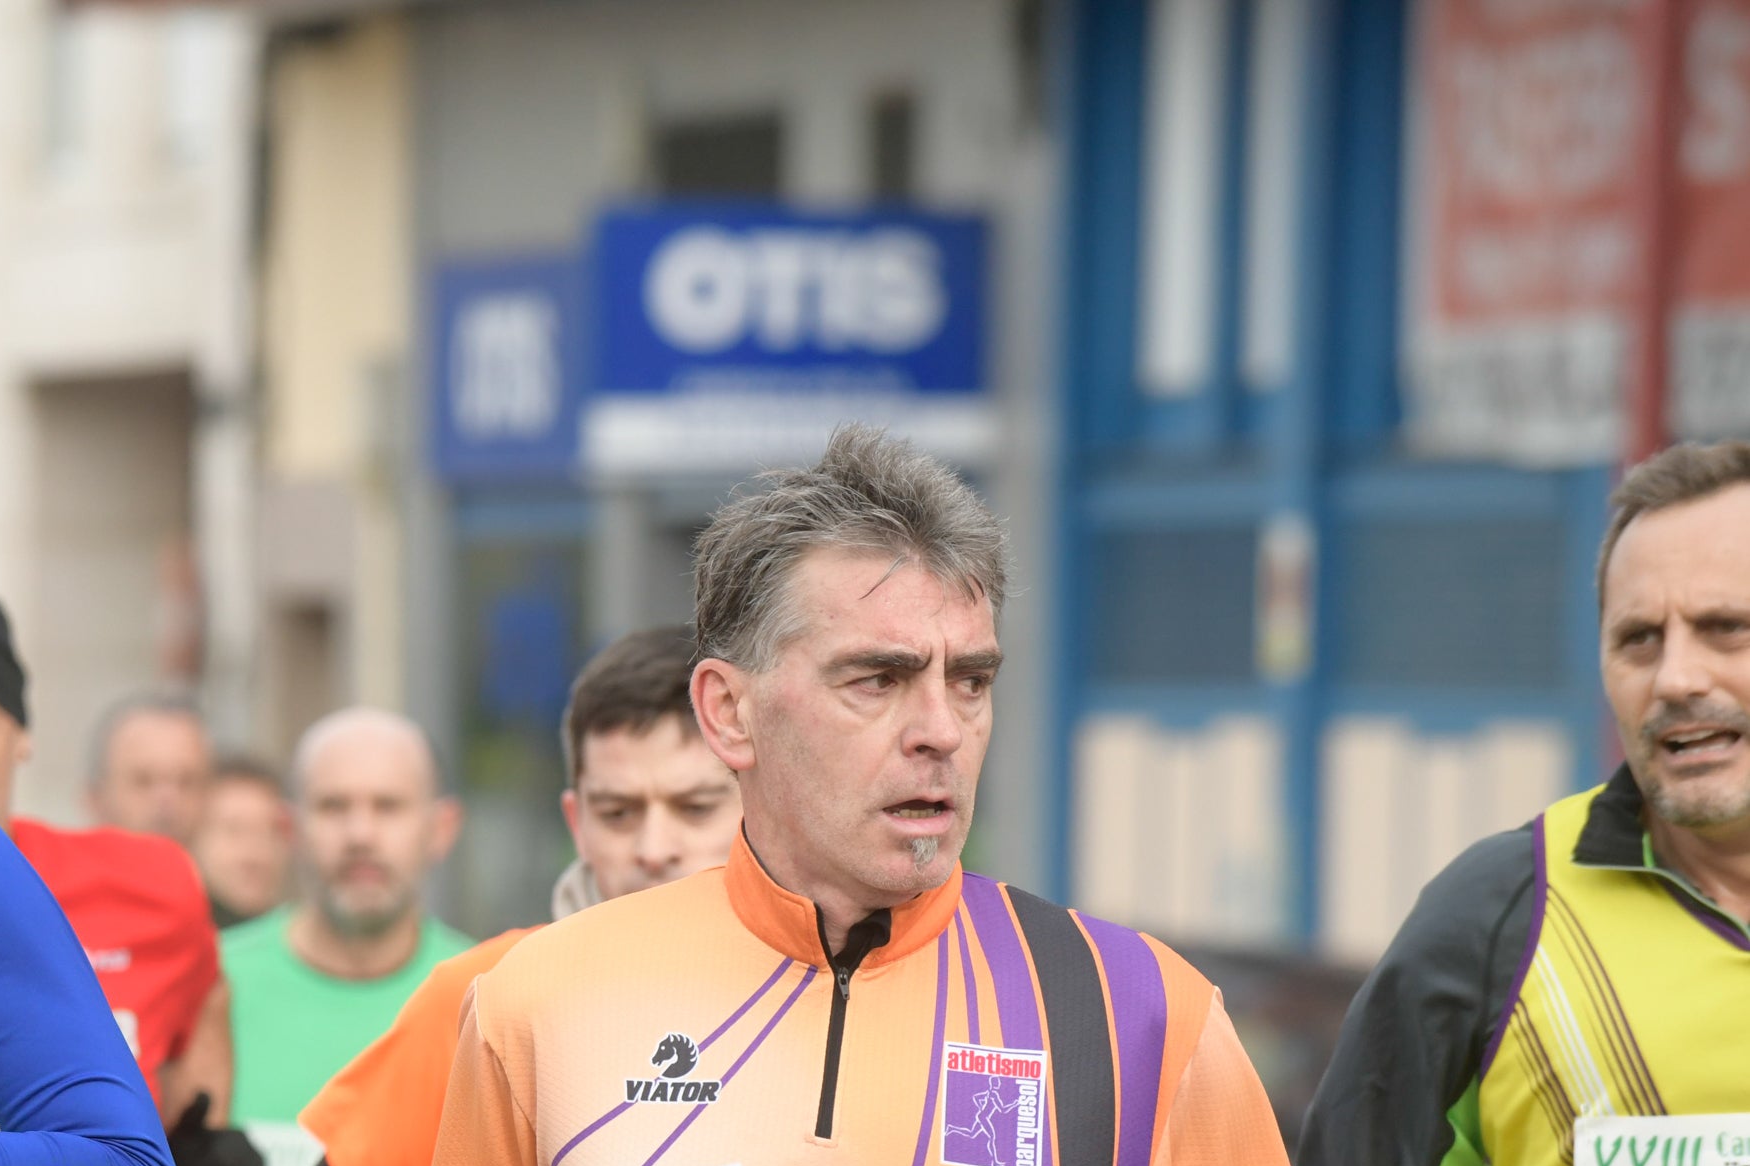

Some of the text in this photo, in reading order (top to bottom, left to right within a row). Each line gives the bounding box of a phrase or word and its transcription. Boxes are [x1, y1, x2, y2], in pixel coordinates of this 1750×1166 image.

[644, 226, 946, 353] OTIS
[947, 1050, 1041, 1078] atletismo
[626, 1080, 720, 1102] VIATOR
